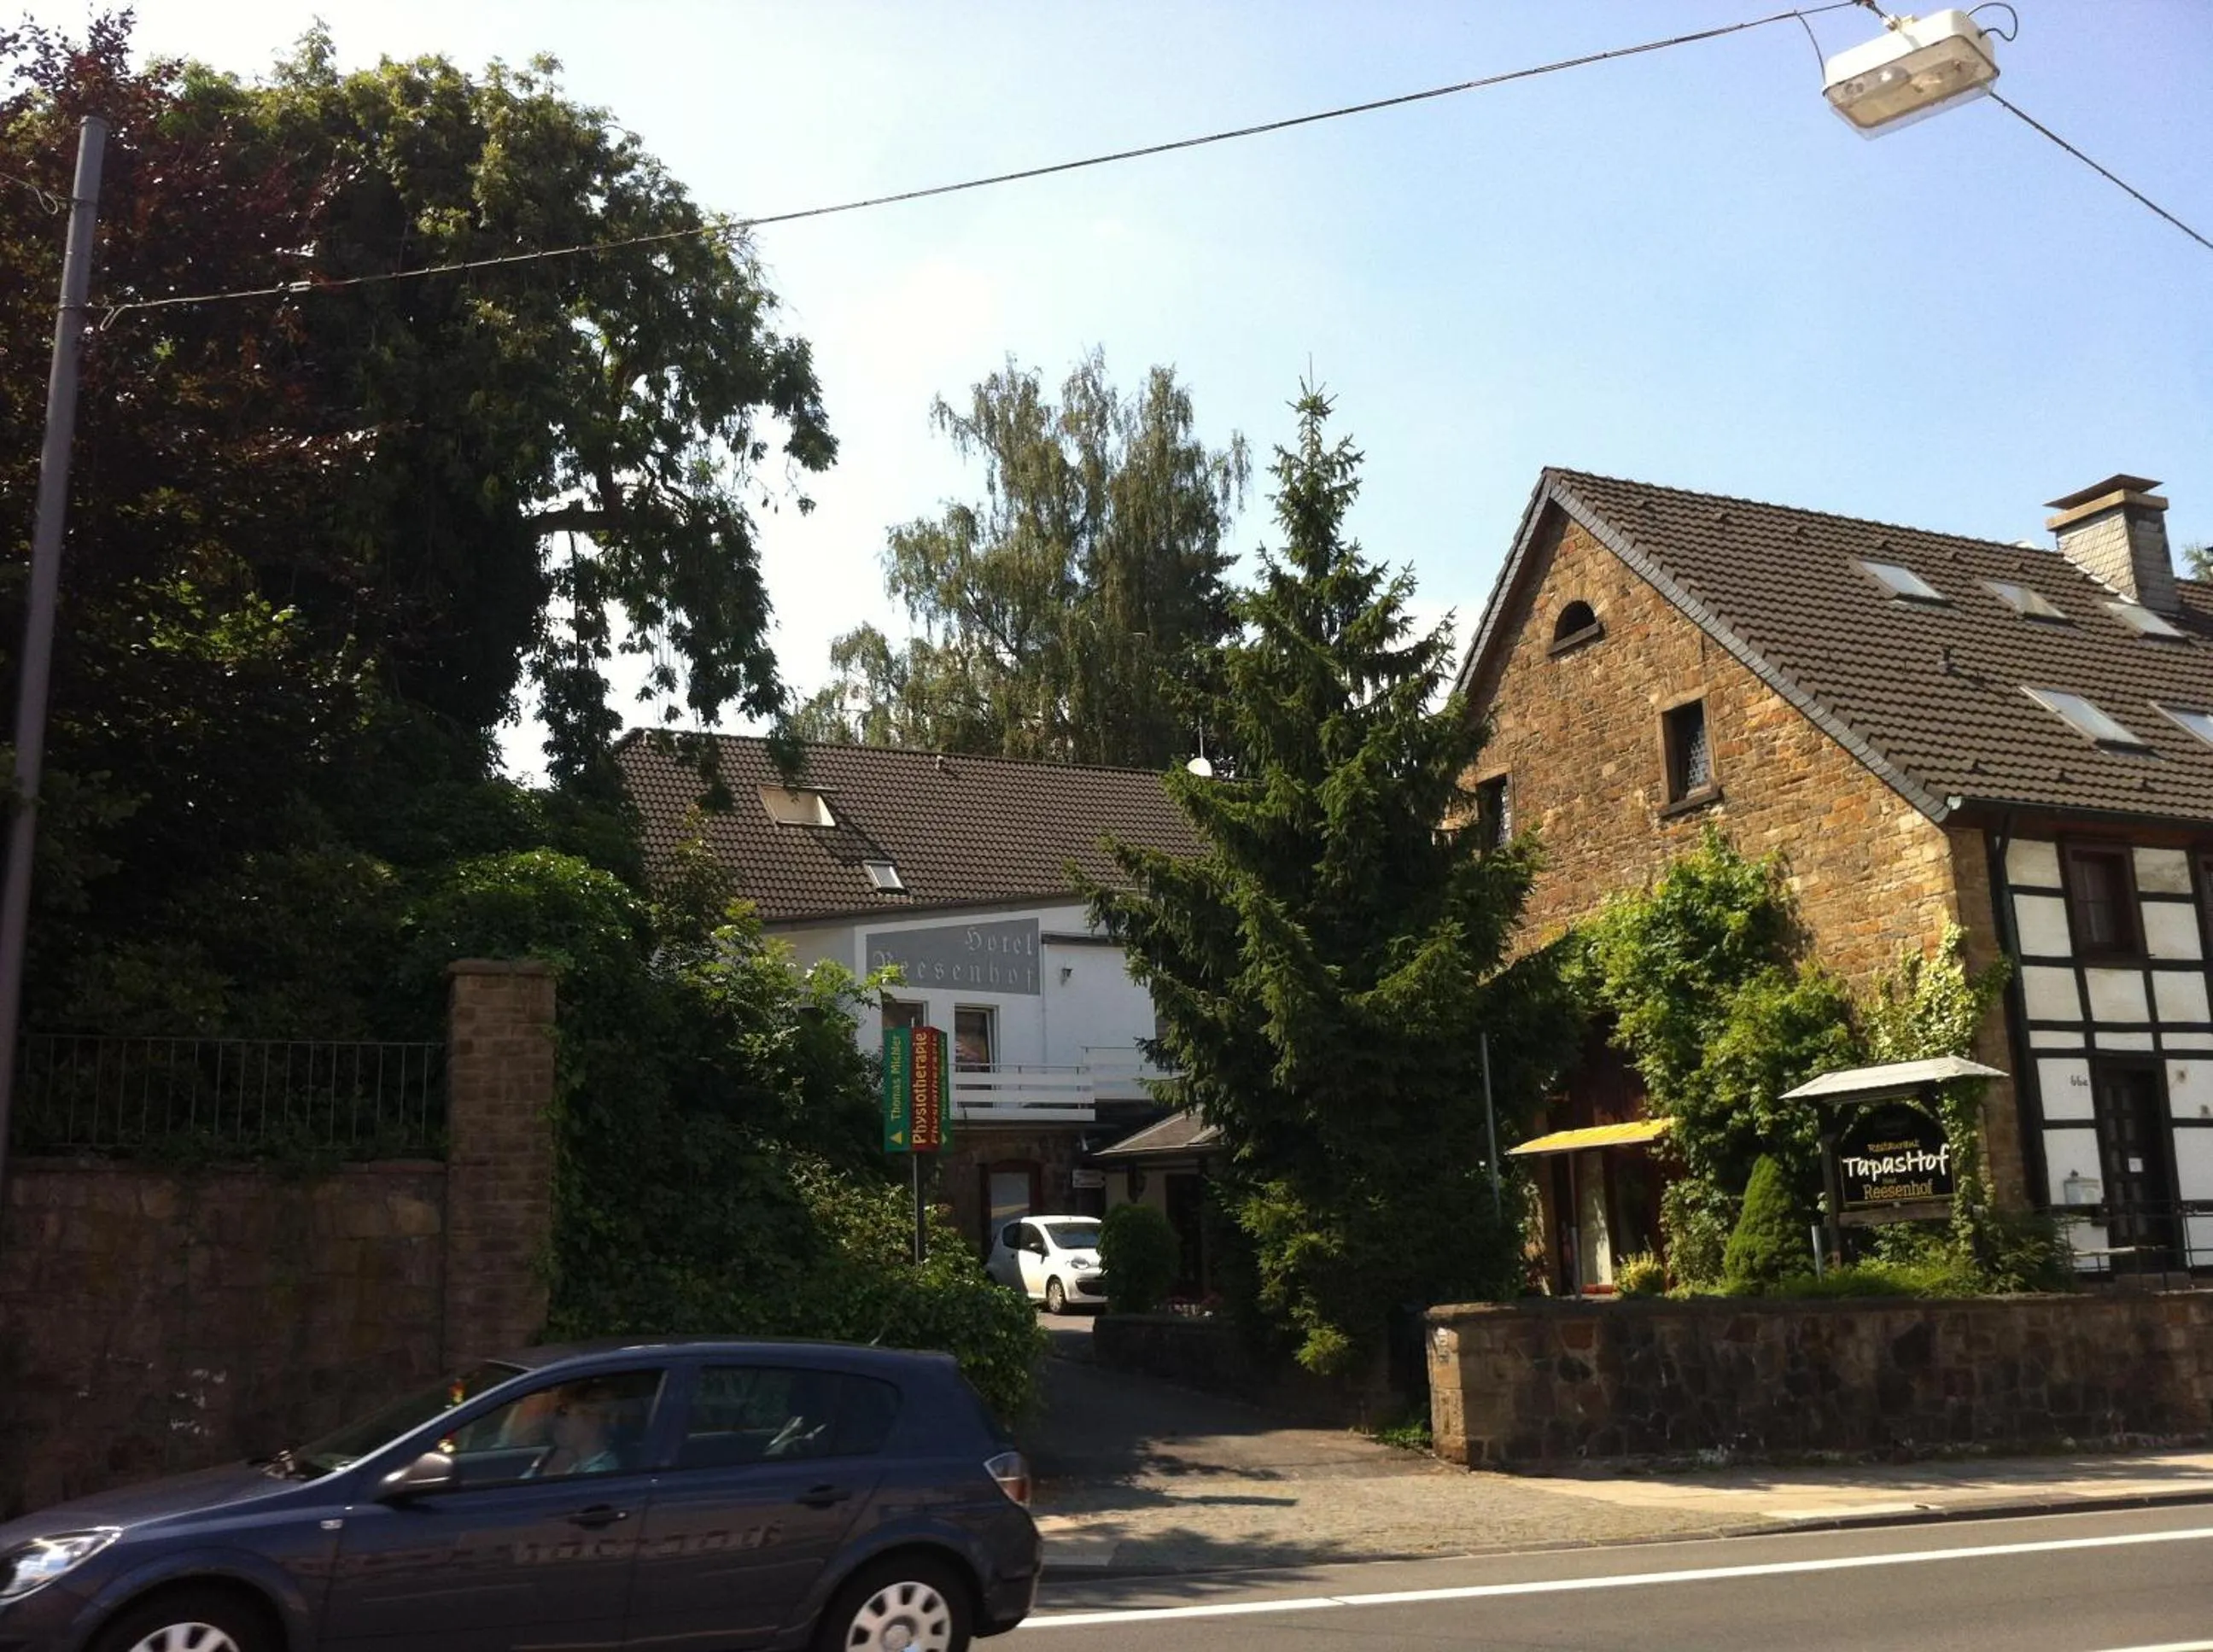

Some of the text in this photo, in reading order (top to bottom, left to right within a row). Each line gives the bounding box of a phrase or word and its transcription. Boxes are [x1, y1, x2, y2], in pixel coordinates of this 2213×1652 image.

[965, 926, 1031, 955] Hotel
[890, 1077, 902, 1122] Thomas
[912, 1031, 928, 1145] Physiotherapie
[1842, 1142, 1950, 1182] TapasHof
[1863, 1178, 1934, 1200] Reesenhof
